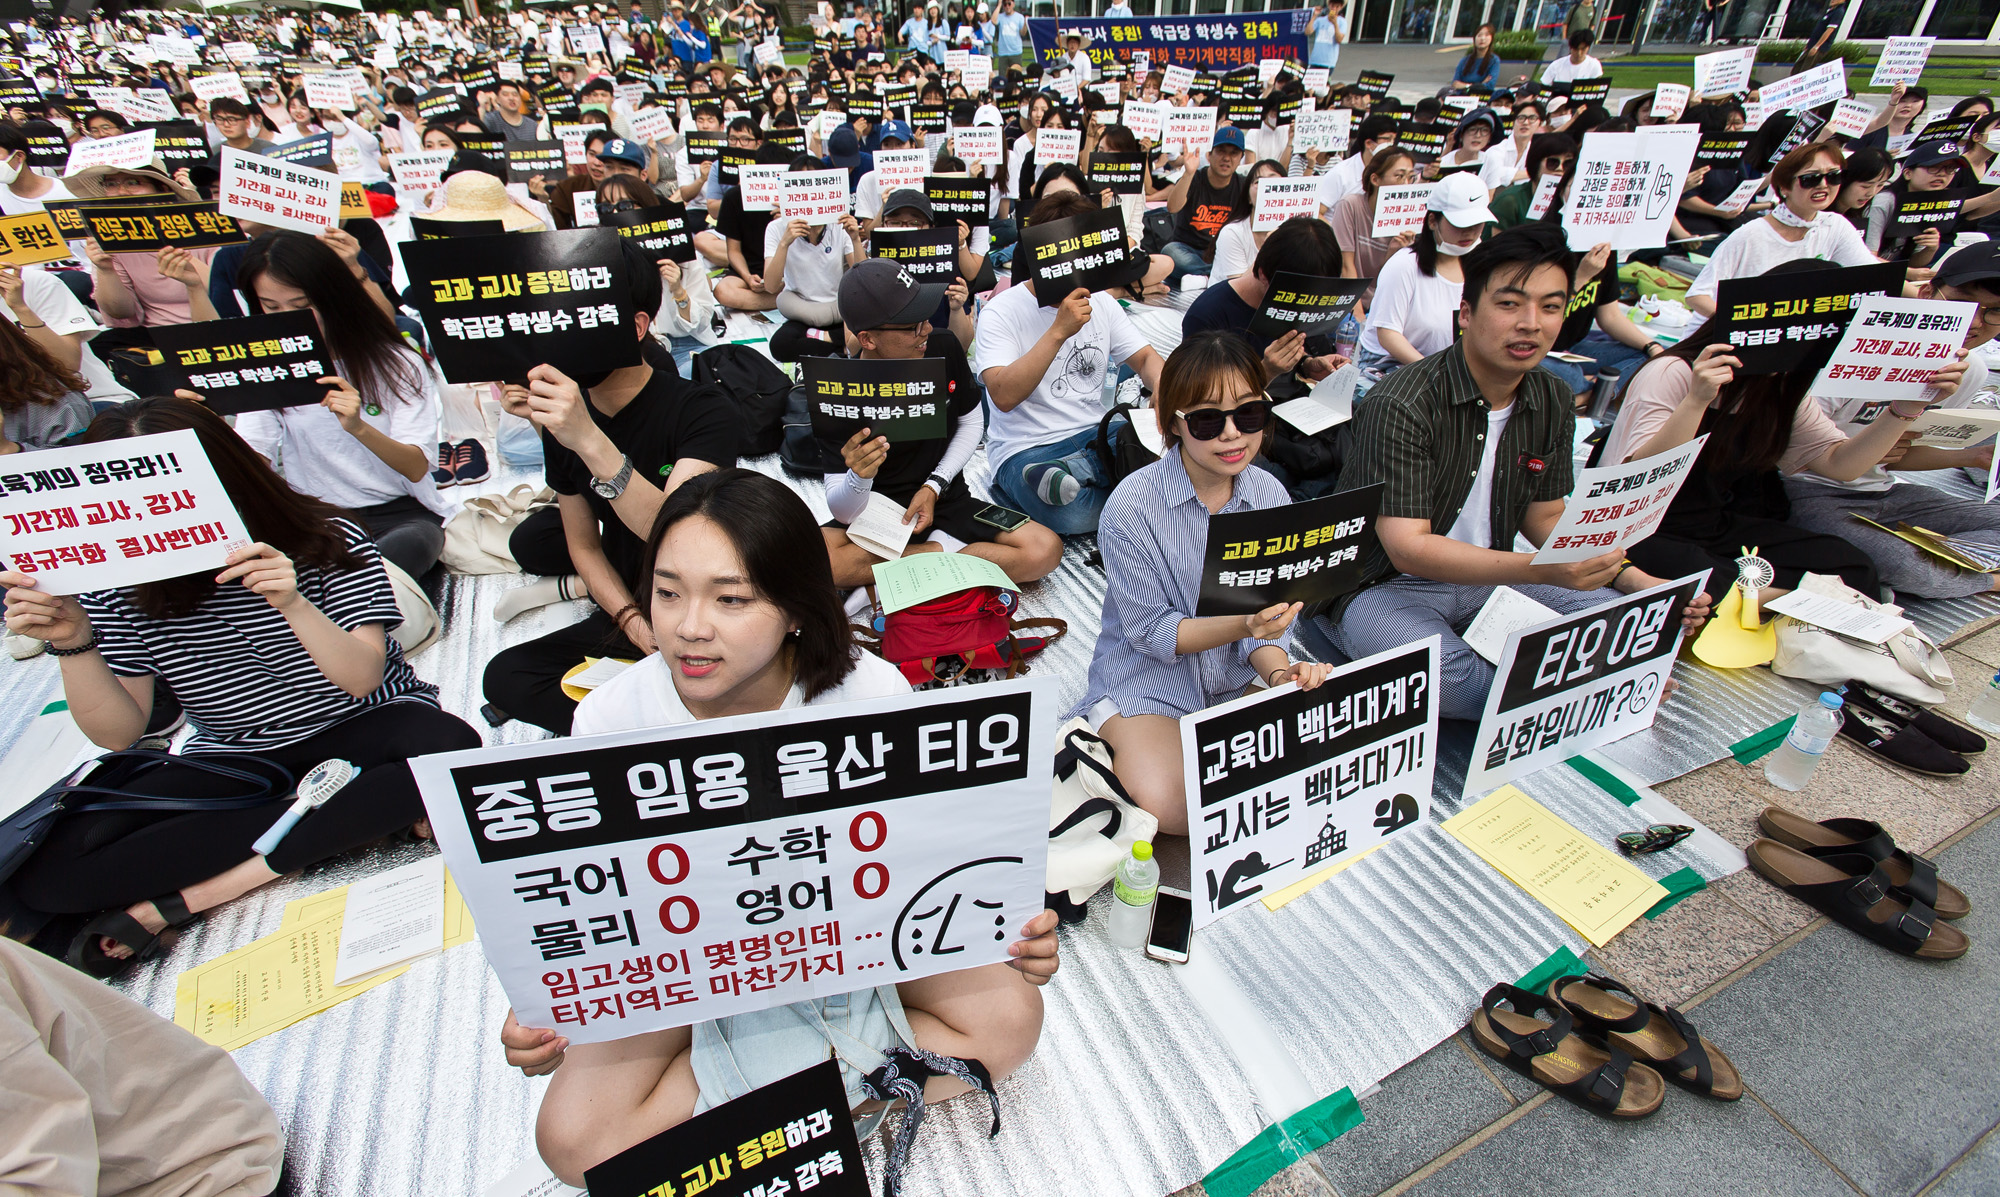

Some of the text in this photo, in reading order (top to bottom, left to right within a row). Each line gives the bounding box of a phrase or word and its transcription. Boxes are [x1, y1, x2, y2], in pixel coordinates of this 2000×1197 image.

[1111, 25, 1142, 42] 증원!
[1149, 24, 1191, 42] 학급당
[1195, 22, 1239, 41] 학생수
[1243, 21, 1278, 40] 감축!
[610, 139, 625, 155] S
[234, 158, 329, 190] 교육계의 정유라!!
[785, 176, 841, 187] 교육계의 정유라!!
[1586, 161, 1650, 175] 기회는 평등하게,
[236, 177, 328, 208] 기간제 교사, 강사
[788, 191, 841, 202] 기간제 교사, 강사
[930, 190, 986, 199] 교과 교사 증원하라
[1581, 178, 1646, 191] 과정은 공정하게,
[228, 193, 330, 226] 정규직화 결사반대!
[785, 204, 845, 216] 정규직화 결사반대!
[931, 203, 985, 212] 학급당 학생수 감축
[1577, 195, 1603, 208] 결과는
[90, 211, 237, 241] 전문교과 정원 확보
[633, 224, 650, 235] 교사
[651, 218, 683, 232] 증원하라
[1573, 211, 1636, 225] 꼭 지켜주십시오!
[12, 224, 58, 249] 확보
[645, 234, 687, 249] 학생수 감축
[1036, 227, 1120, 259] 교과 교사 증원하라
[880, 244, 953, 258] 교과 교사 증원하라
[1040, 248, 1123, 279] 학급당 학생수 감축
[897, 269, 913, 289] H
[908, 261, 952, 273] 학생수 감축
[431, 267, 612, 302] 교과 교사 증원하라
[1273, 291, 1355, 305] 교과 교사 증원하라
[441, 304, 619, 340] 학급당 학생수 감축
[1266, 308, 1344, 322] 학급당 학생수 감축
[1732, 303, 1768, 320] 교과
[1772, 299, 1809, 317] 교사
[1862, 311, 1962, 331] 교육계의 정유라!!
[1730, 323, 1838, 346] 학급당 학생수
[1850, 338, 1951, 359] 기간제 교사, 강사
[177, 336, 313, 365] 교과 교사 증원하라
[189, 360, 323, 388] 학급당 학생수 감축
[1829, 364, 1882, 380] 정규직화
[817, 381, 935, 396] 교과 교사 증원하라
[819, 403, 935, 419] 학급당 학생수 감축
[80, 453, 182, 484] 정유라!!
[1528, 462, 1543, 470] 기회
[1587, 453, 1690, 498] 교육계의 정유라!!
[3, 490, 195, 535] 기간제 교사, 강사
[1576, 483, 1674, 524] 기간제 교사, 강사
[1223, 517, 1366, 560] 교과 교사 증원하라
[1552, 505, 1665, 548] 정규직화 결사반대!
[10, 522, 228, 573] 정규직화 결사반대!
[1219, 546, 1358, 586] 학급당 학생수 감축
[1531, 595, 1673, 690] 티오 0명
[1202, 671, 1428, 785] 교육이 백년대계?
[1483, 678, 1635, 772] 실화입니까?
[472, 712, 1022, 844] 중등 임용 울산 티오
[1202, 730, 1424, 855] 교사는 백년대기!
[513, 857, 628, 906] 국어
[728, 825, 831, 876] 수학
[531, 909, 640, 961] 물리
[736, 876, 833, 925] 영어
[541, 919, 843, 998] 임고생이 몇명인데
[550, 950, 845, 1025] 타지역도 마찬가지
[681, 1109, 834, 1191] 교사 증원하라
[795, 1150, 843, 1191] 감축
